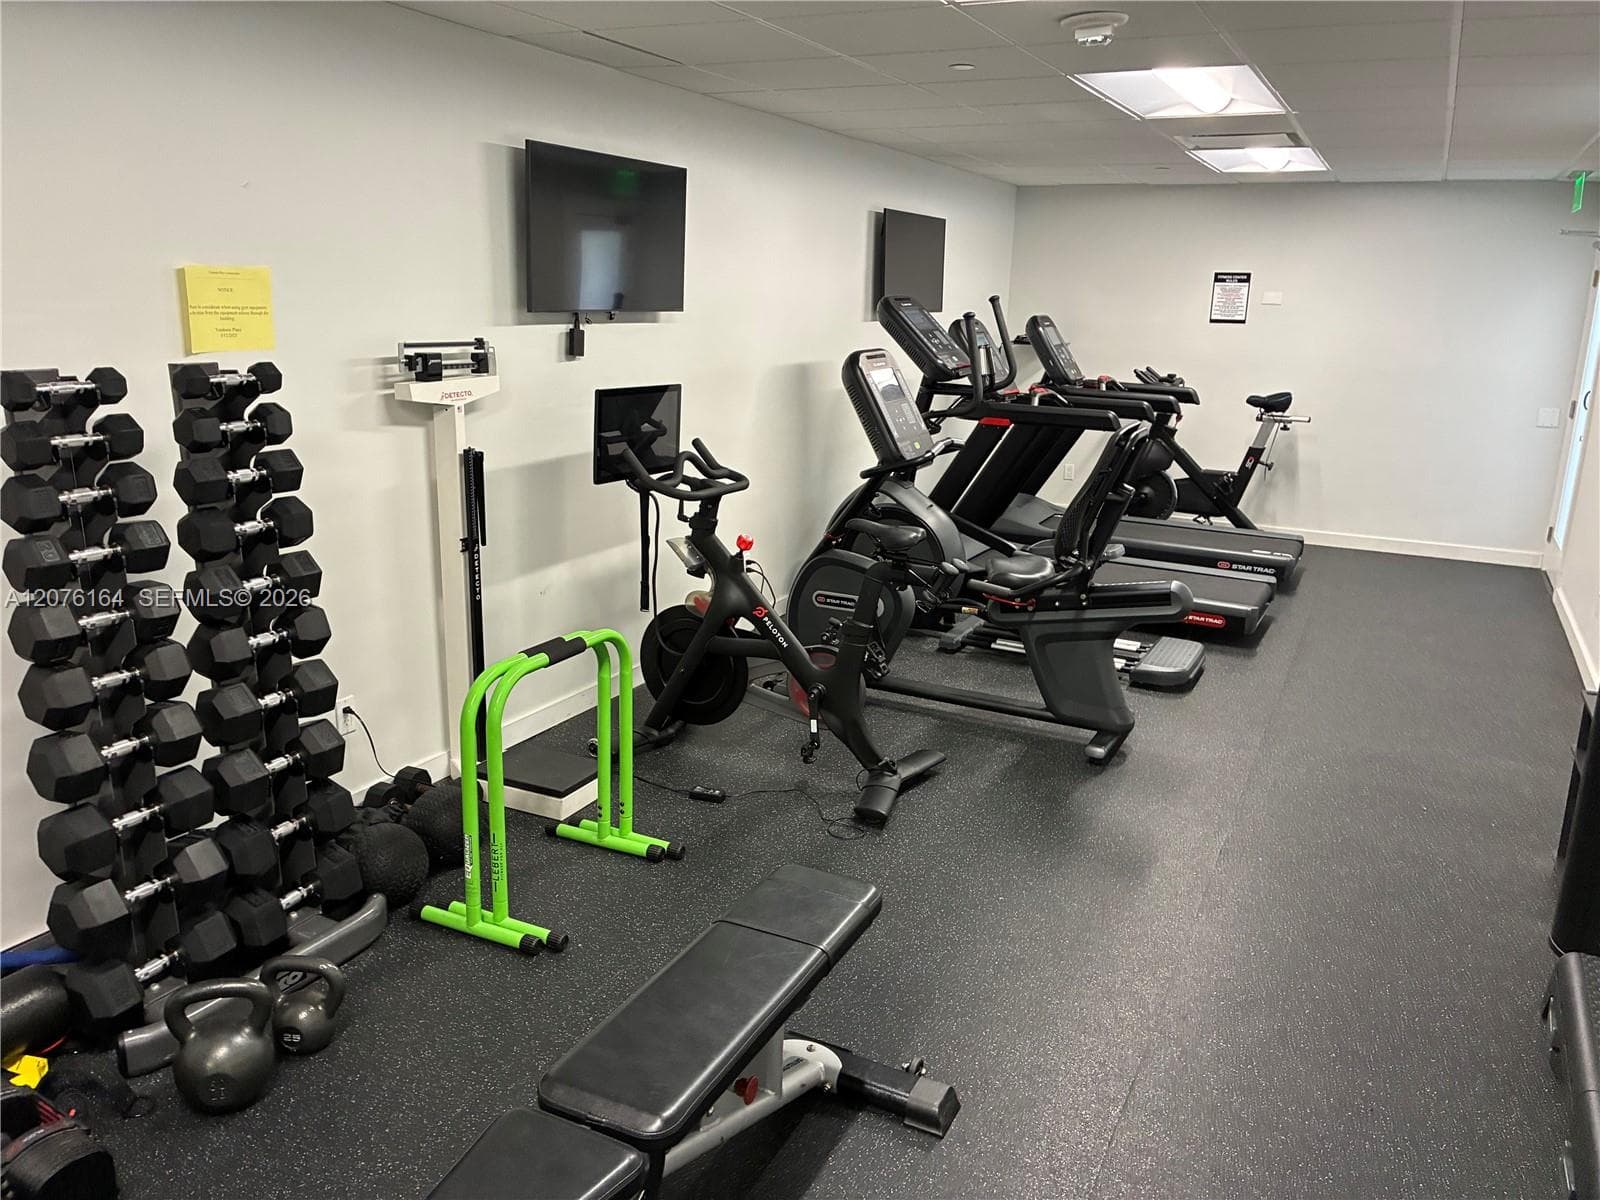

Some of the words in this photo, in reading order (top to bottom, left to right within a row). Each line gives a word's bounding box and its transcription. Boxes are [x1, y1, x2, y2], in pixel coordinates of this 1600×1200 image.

[1231, 563, 1252, 571] STAR
[1252, 566, 1276, 574] TRAC
[762, 616, 789, 648] PELOTON
[491, 843, 500, 881] LEBERT
